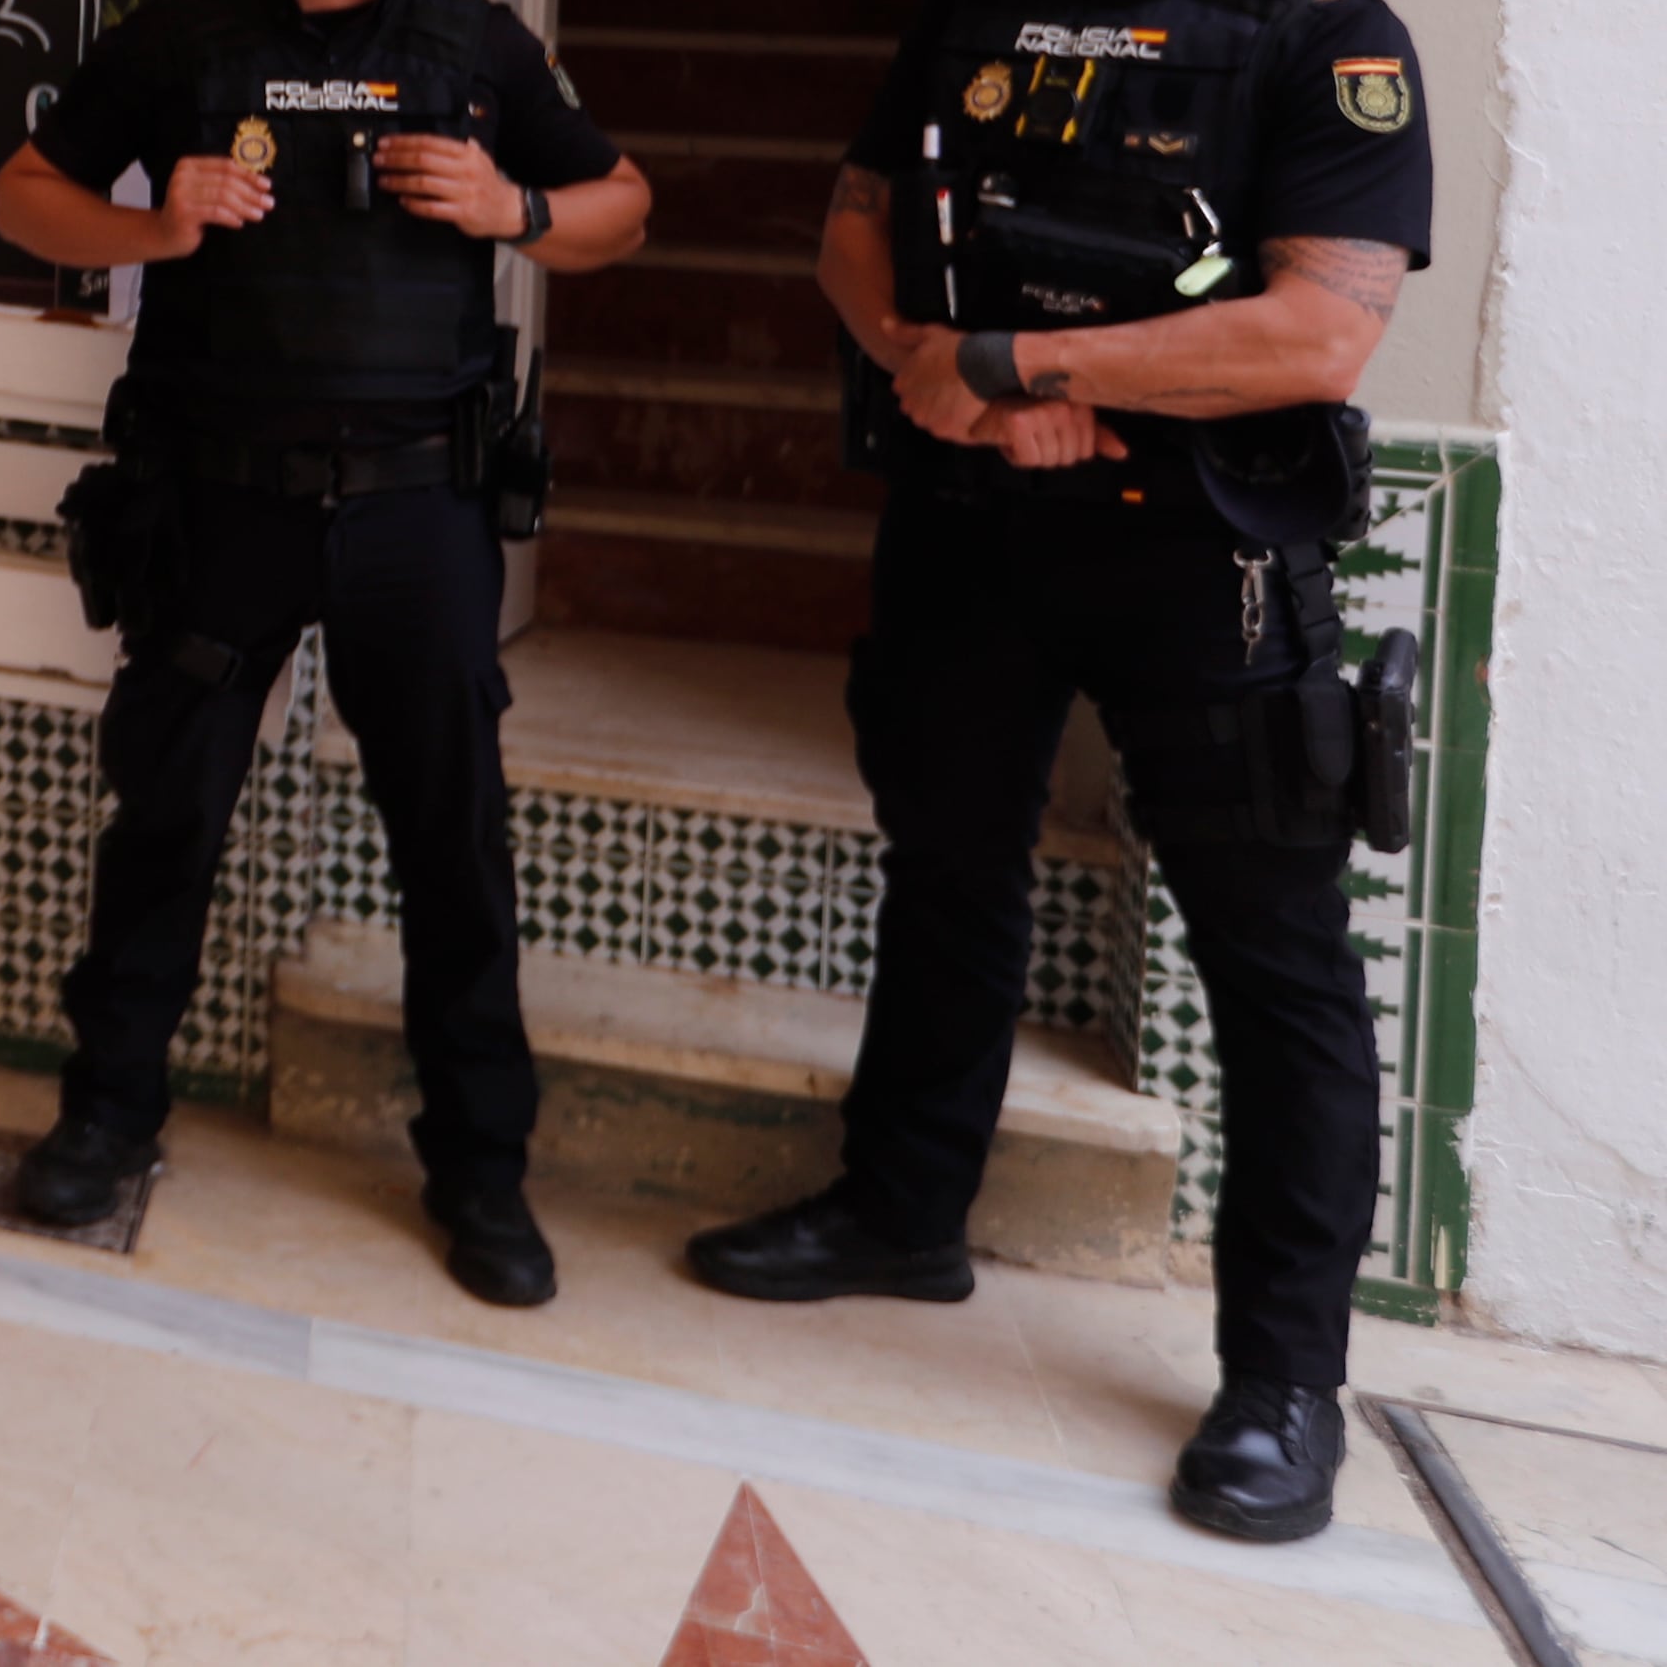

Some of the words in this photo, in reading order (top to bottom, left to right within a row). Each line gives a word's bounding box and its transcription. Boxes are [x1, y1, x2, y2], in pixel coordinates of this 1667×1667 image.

[1019, 21, 1132, 45] POLICIA
[1014, 36, 1162, 61] NACIONAL
[265, 80, 369, 97] POLICIA
[266, 93, 399, 111] NACIONAL
